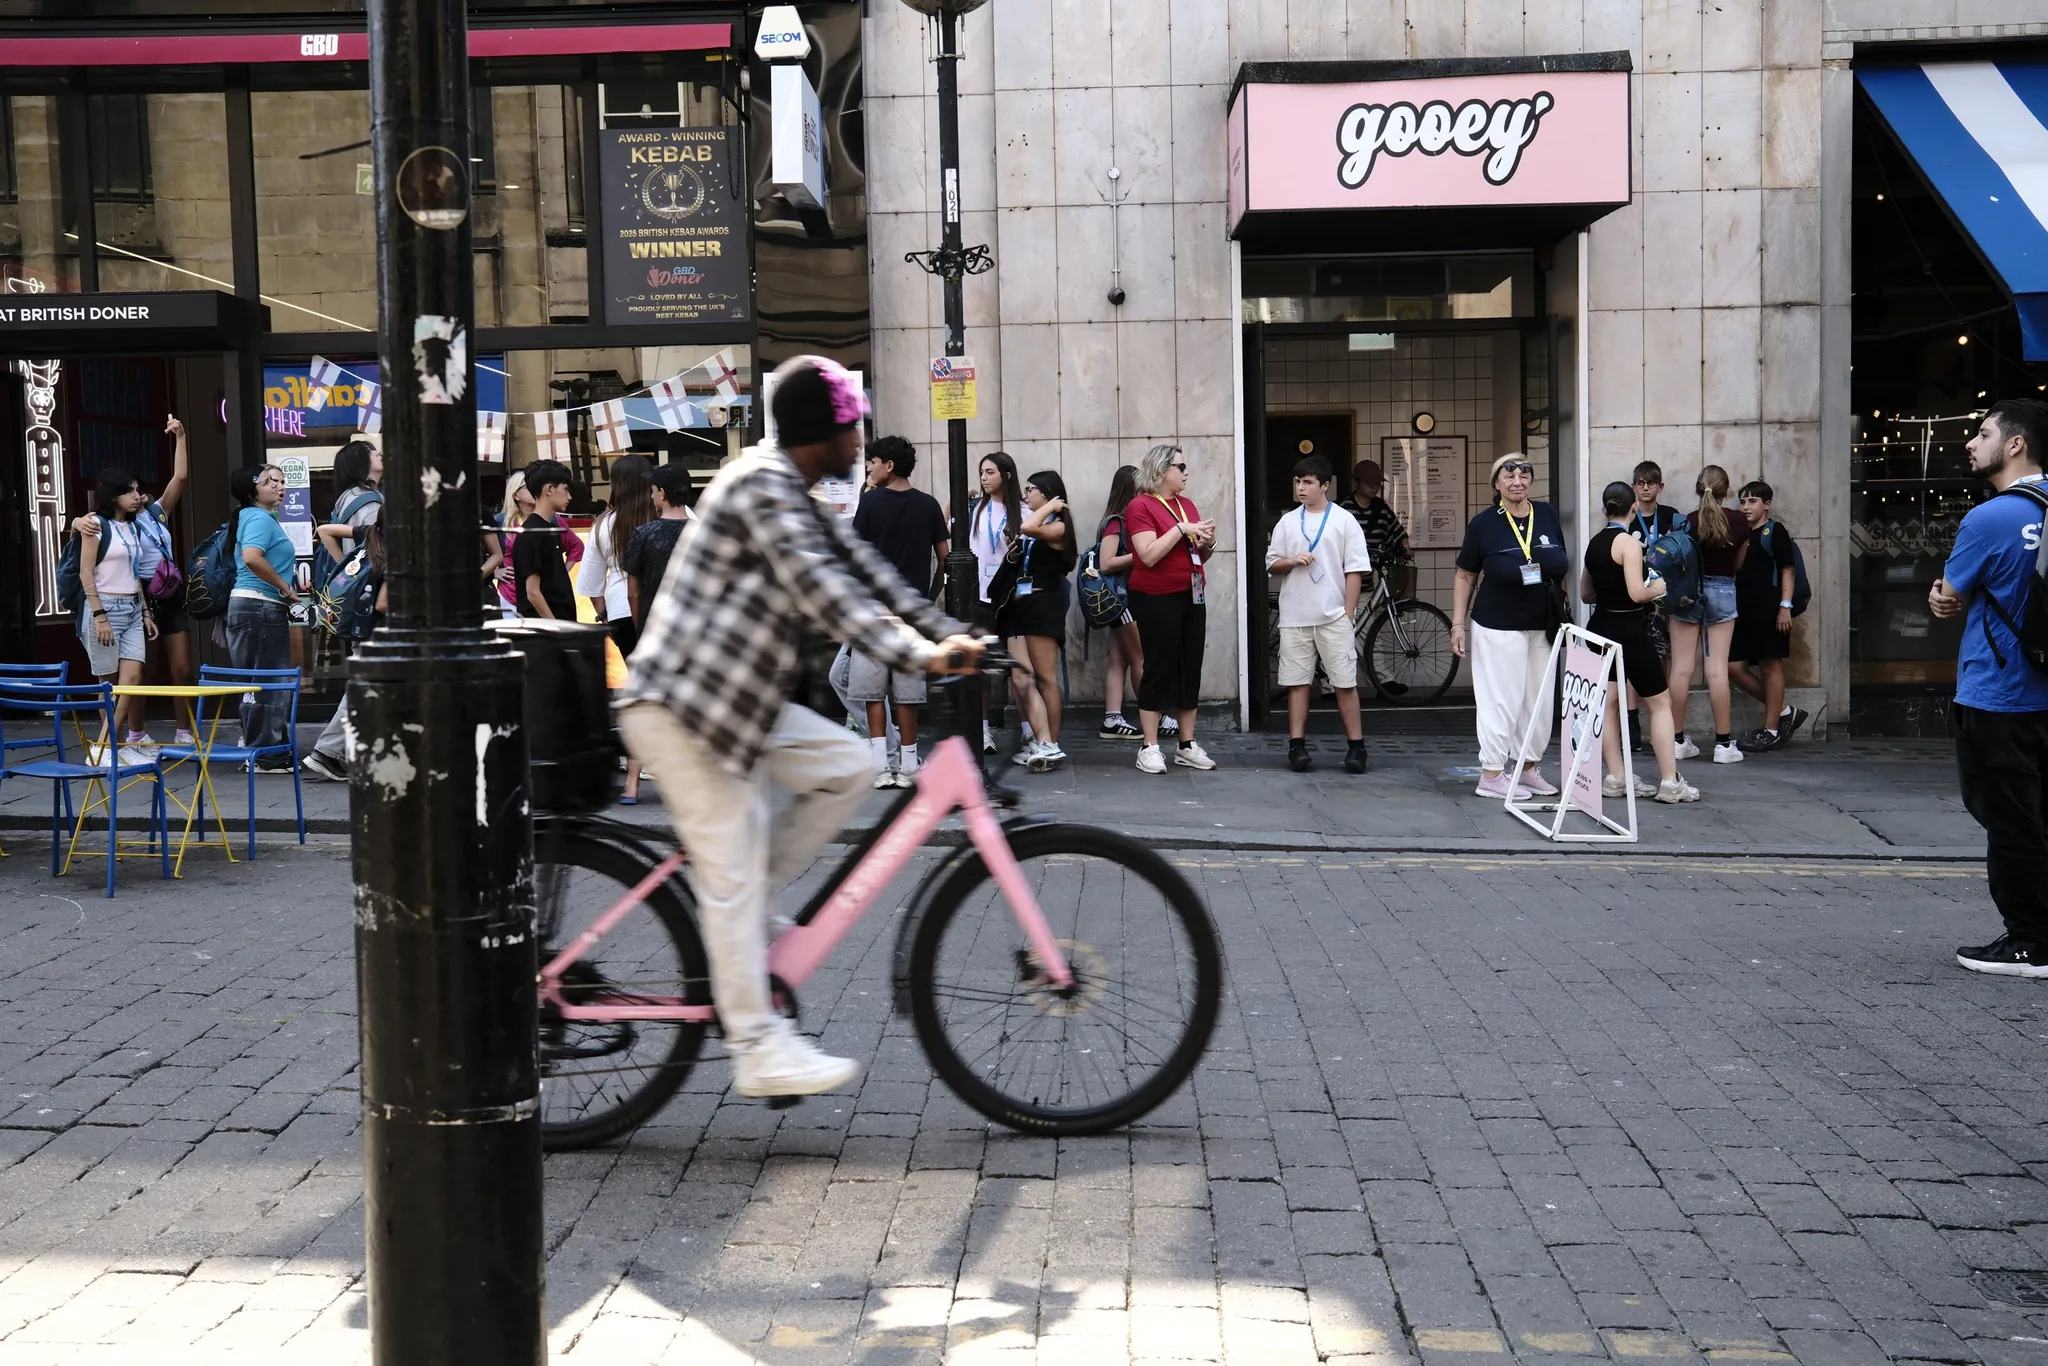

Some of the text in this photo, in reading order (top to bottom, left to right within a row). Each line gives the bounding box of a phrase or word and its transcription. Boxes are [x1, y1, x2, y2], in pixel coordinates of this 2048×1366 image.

[301, 34, 339, 56] GBD
[761, 32, 801, 43] SECOM
[618, 133, 661, 143] AWARD
[1336, 91, 1554, 189] gooey
[631, 145, 713, 164] KEBAB
[638, 228, 668, 237] BRITISH
[670, 228, 696, 236] KEBAB
[697, 226, 730, 236] AWARDS
[629, 241, 722, 259] WINNER
[659, 270, 705, 286] Doner
[673, 266, 696, 275] GBD
[20, 307, 85, 321] BRITISH
[89, 306, 150, 320] DONER
[628, 305, 661, 313] PROUDLY
[661, 304, 693, 312] SERVING
[271, 406, 307, 437] HERE
